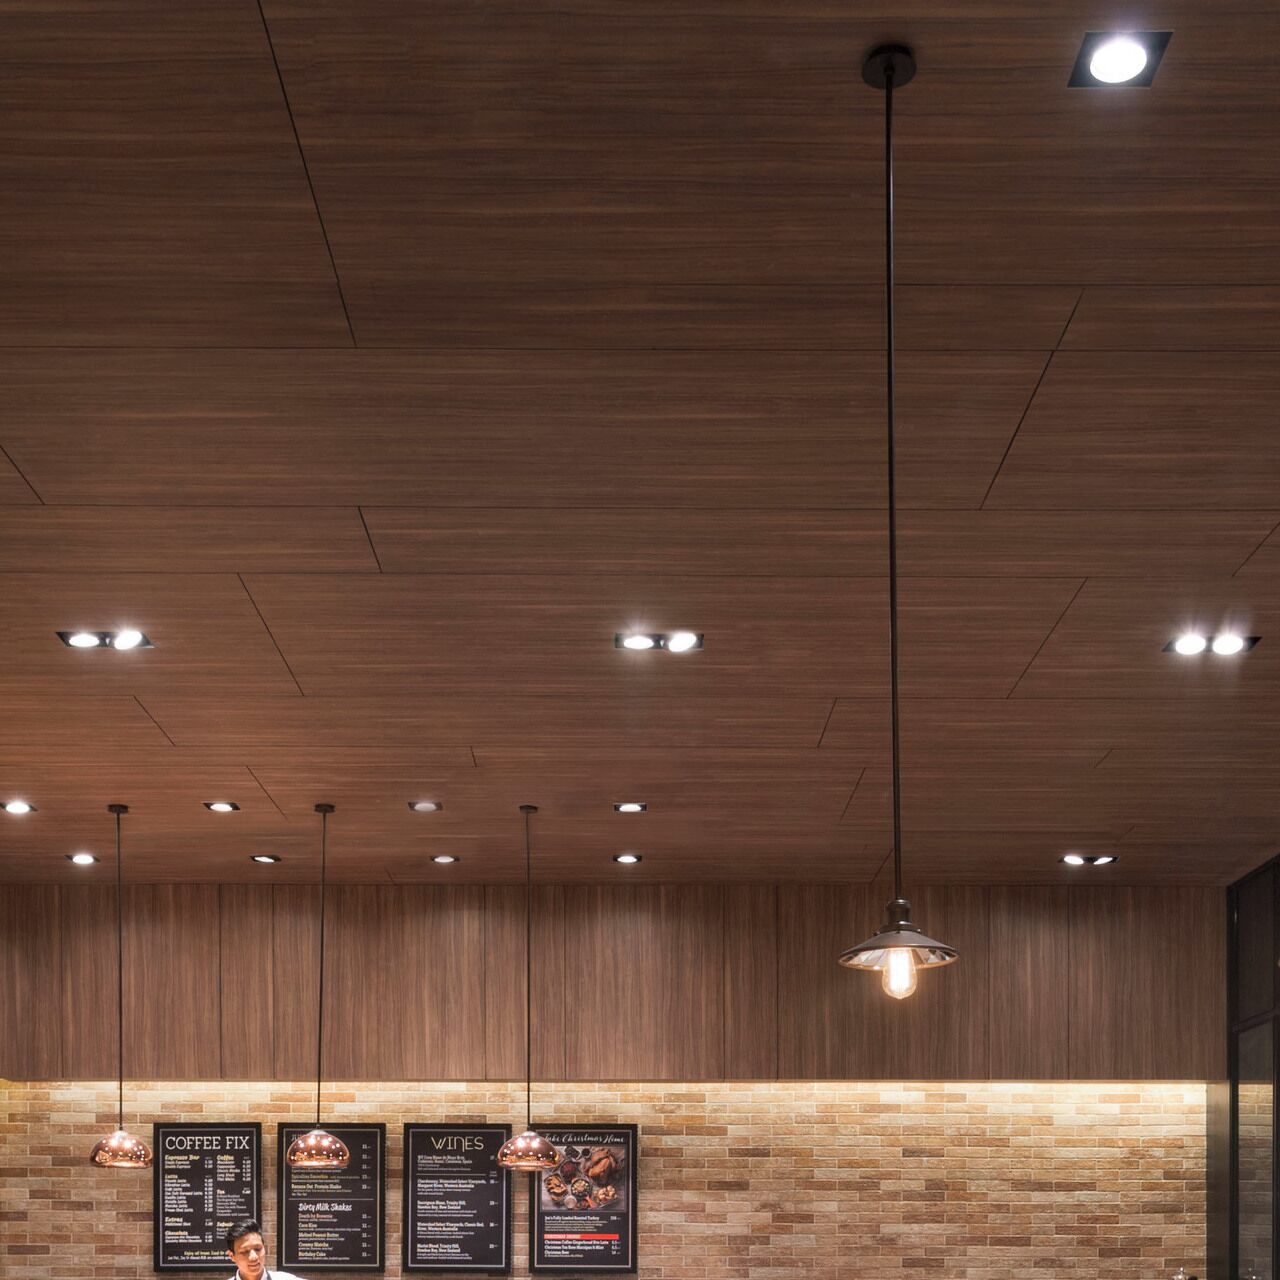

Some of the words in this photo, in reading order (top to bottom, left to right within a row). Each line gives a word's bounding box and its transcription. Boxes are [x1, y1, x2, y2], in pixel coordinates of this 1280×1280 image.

[165, 1136, 221, 1150] COFFEE
[225, 1136, 250, 1150] FIX
[562, 1133, 602, 1143] Christmas
[603, 1134, 624, 1143] Home
[430, 1136, 484, 1153] WINES
[298, 1202, 315, 1212] Dirty
[315, 1202, 330, 1211] Milk
[330, 1202, 352, 1211] Shakes
